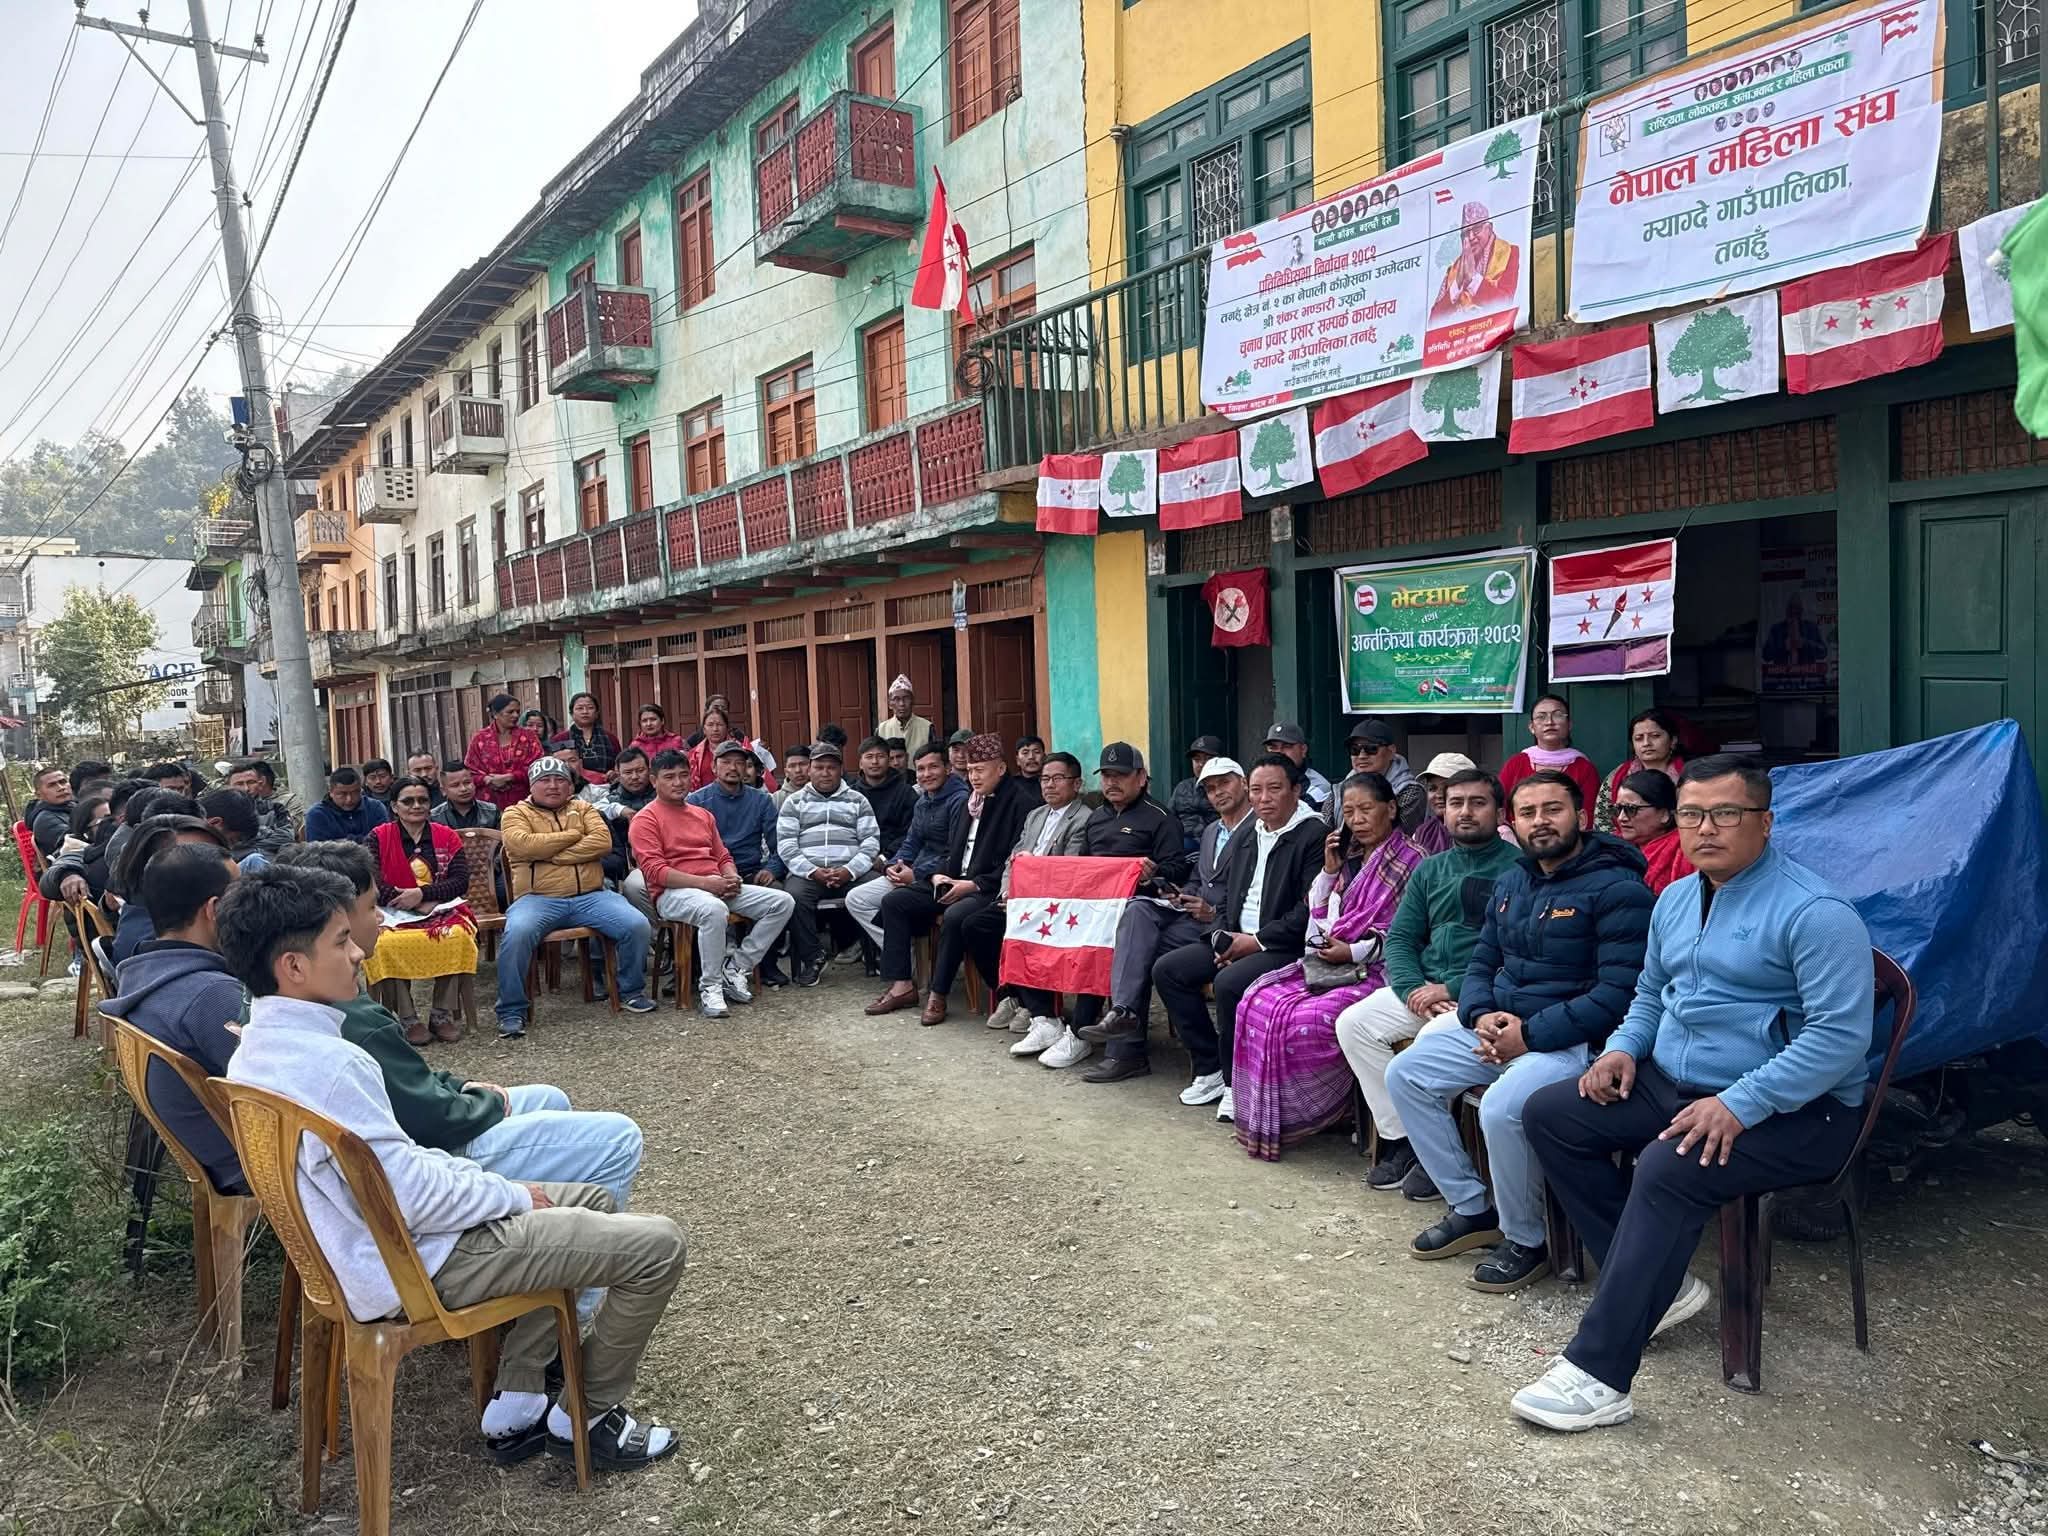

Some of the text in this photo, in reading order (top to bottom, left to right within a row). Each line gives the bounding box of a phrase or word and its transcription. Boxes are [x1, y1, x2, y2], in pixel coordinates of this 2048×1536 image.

[1817, 57, 1845, 74] एकता
[1609, 89, 1900, 206] नेपाल महिला संघ
[1643, 201, 1710, 242] म्याग्दे
[1351, 245, 1376, 265] २०८२
[1715, 225, 1769, 265] तनहुँ
[1297, 281, 1327, 301] नेपाली
[1301, 297, 1335, 317] भण्डारी
[1240, 336, 1263, 358] चुनाव
[1266, 330, 1288, 350] प्रचार
[1291, 322, 1315, 343] प्रसार
[1352, 299, 1397, 324] कार्यालय
[1254, 349, 1285, 369] म्याग्दे
[1391, 584, 1469, 609] भेटघाट
[1421, 611, 1439, 623] तथा
[532, 757, 564, 778] BOY
